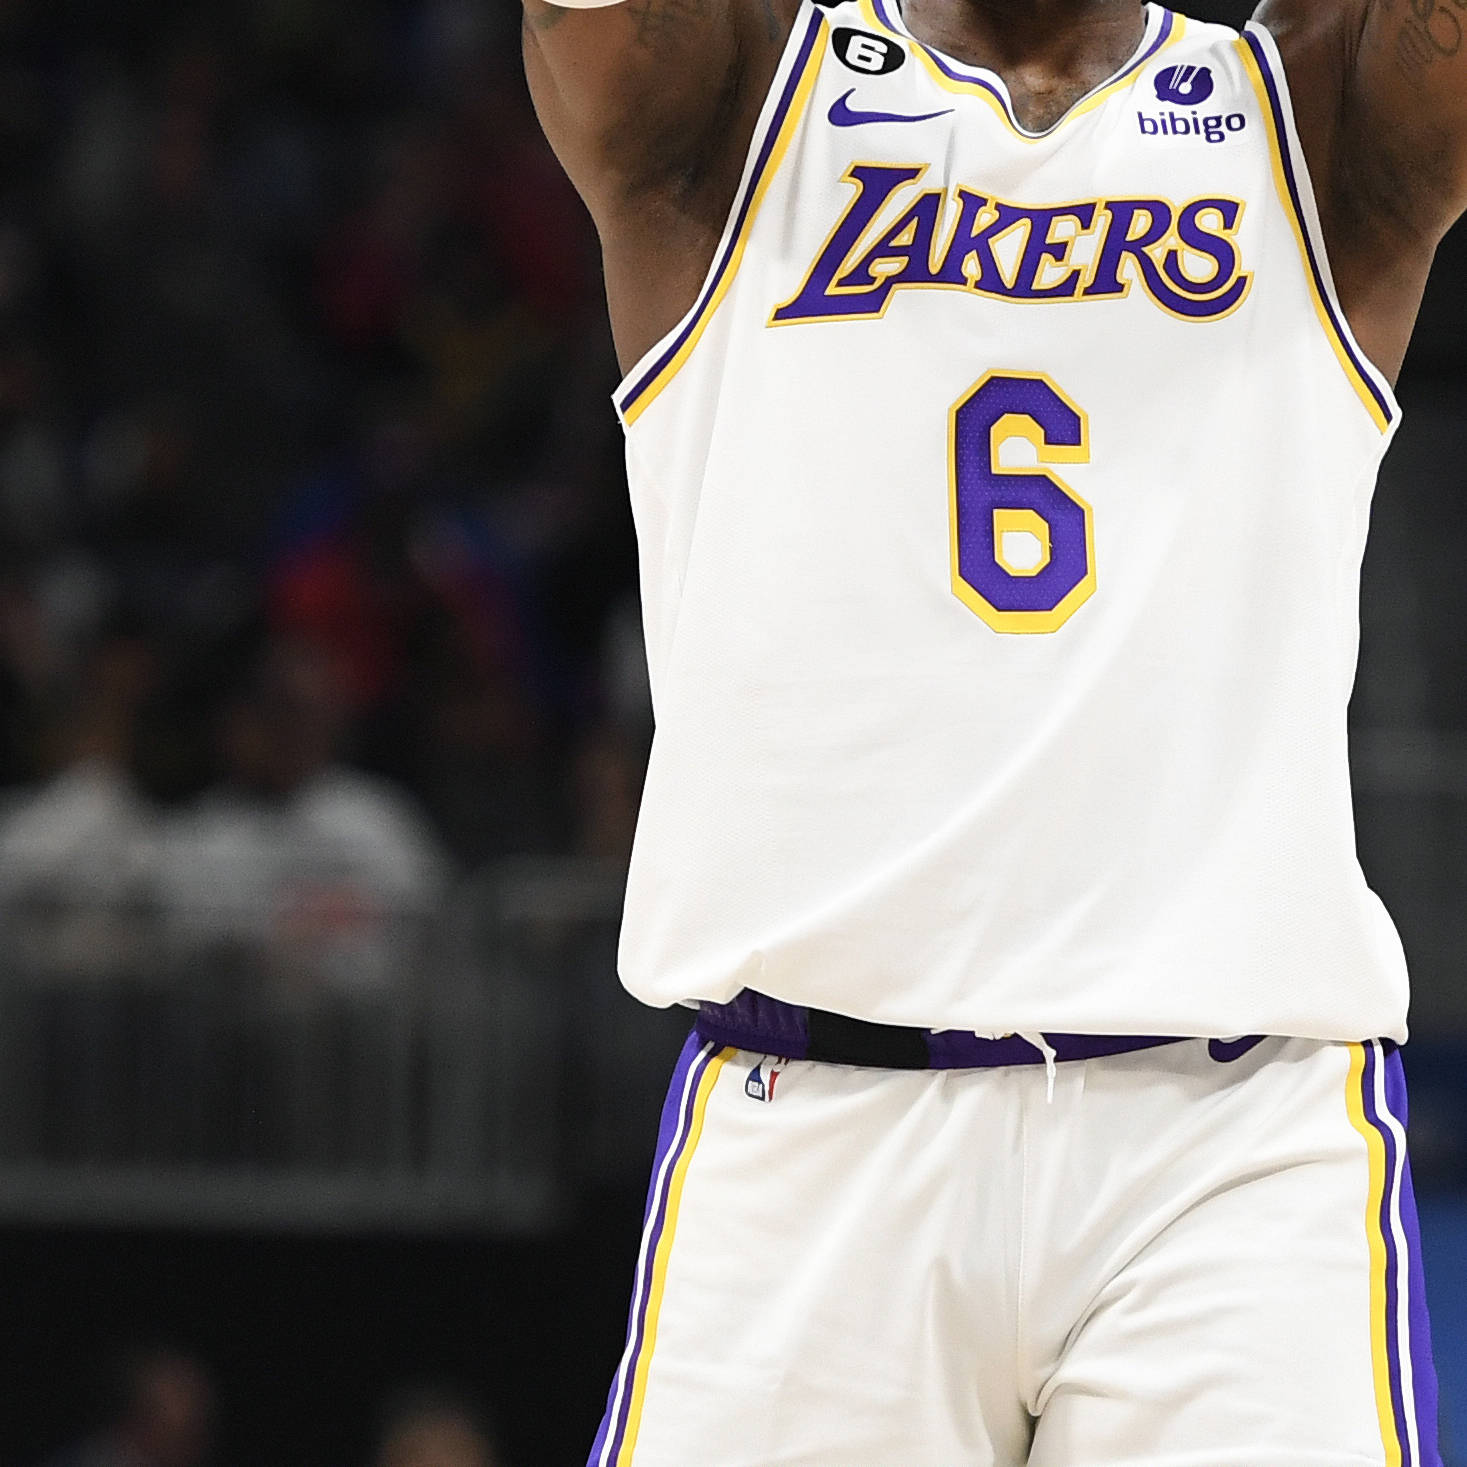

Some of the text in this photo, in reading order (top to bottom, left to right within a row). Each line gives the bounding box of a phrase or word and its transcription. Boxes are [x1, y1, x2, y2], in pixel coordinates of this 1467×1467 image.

[845, 34, 889, 72] 6
[1136, 110, 1246, 144] bibigo
[765, 161, 1255, 328] LAKERS
[947, 368, 1097, 634] 6
